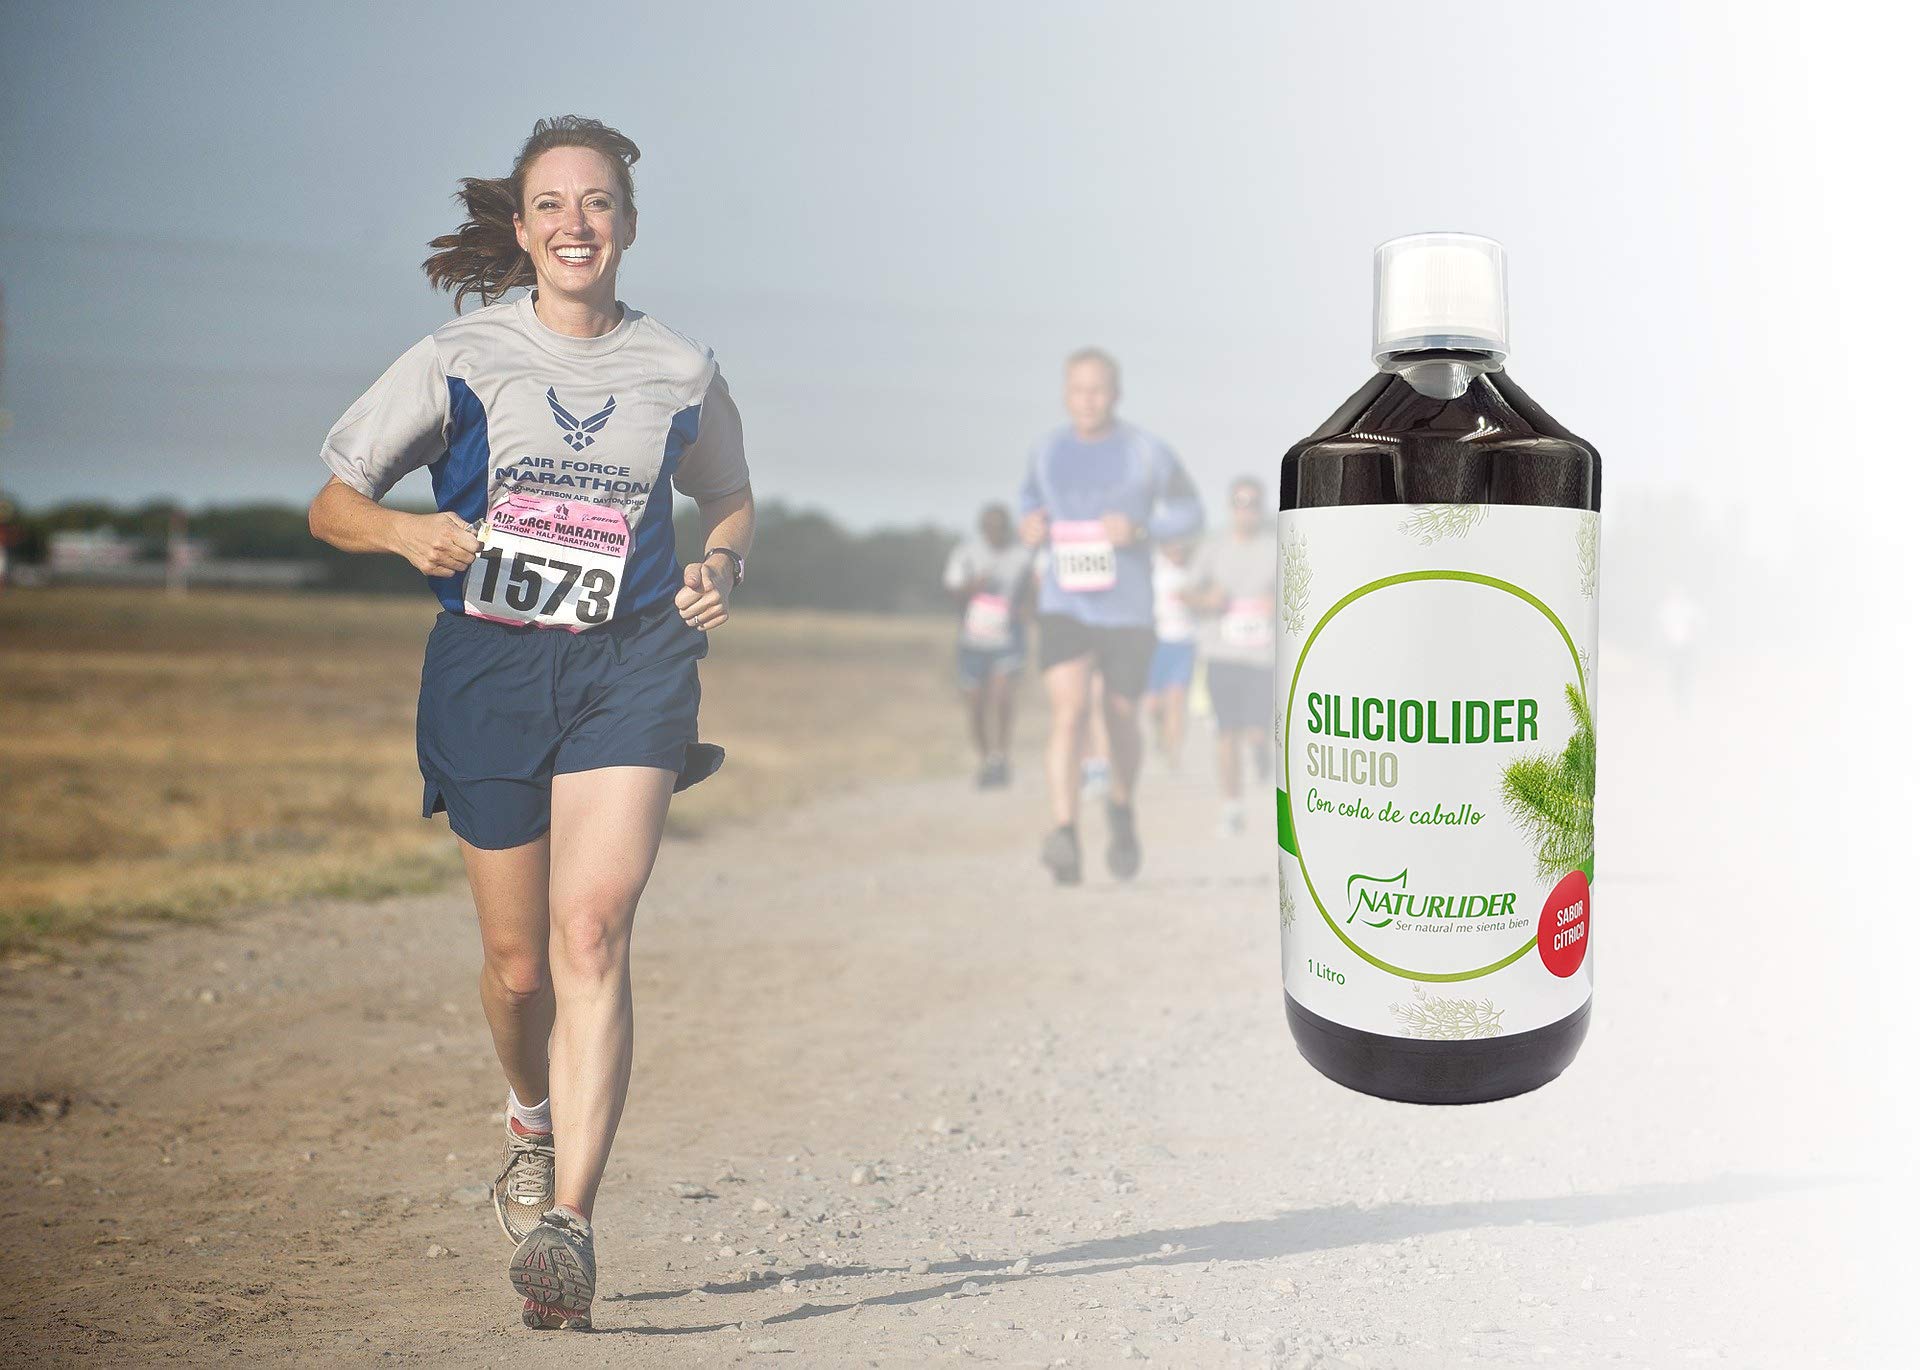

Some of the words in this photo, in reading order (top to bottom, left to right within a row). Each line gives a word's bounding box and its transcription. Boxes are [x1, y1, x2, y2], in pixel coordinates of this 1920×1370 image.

[495, 468, 650, 494] MARATHON
[518, 456, 555, 469] AIR
[561, 460, 630, 477] FORCE
[493, 511, 516, 525] AIR
[518, 517, 552, 531] ORCE
[555, 523, 627, 546] MARATHON
[536, 530, 556, 540] HALF
[557, 535, 601, 549] MARATHON
[606, 545, 621, 554] 10K
[480, 547, 616, 623] 1573
[1307, 691, 1539, 744] SILICIOLIDER
[1306, 742, 1399, 788] SILICIO
[1307, 787, 1335, 813] Con
[1338, 798, 1374, 820] cola
[1378, 801, 1405, 823] de
[1409, 803, 1486, 825] caballo
[1346, 888, 1517, 924] NATURLIDER
[1556, 899, 1584, 927] SABOR
[1395, 920, 1413, 932] Ser
[1415, 922, 1453, 933] natural
[1456, 925, 1473, 933] me
[1475, 921, 1506, 932] sienta
[1508, 918, 1529, 930] bien
[1553, 921, 1586, 951] CÍTRICO
[1308, 958, 1313, 973] 1
[1316, 962, 1346, 985] Litro
